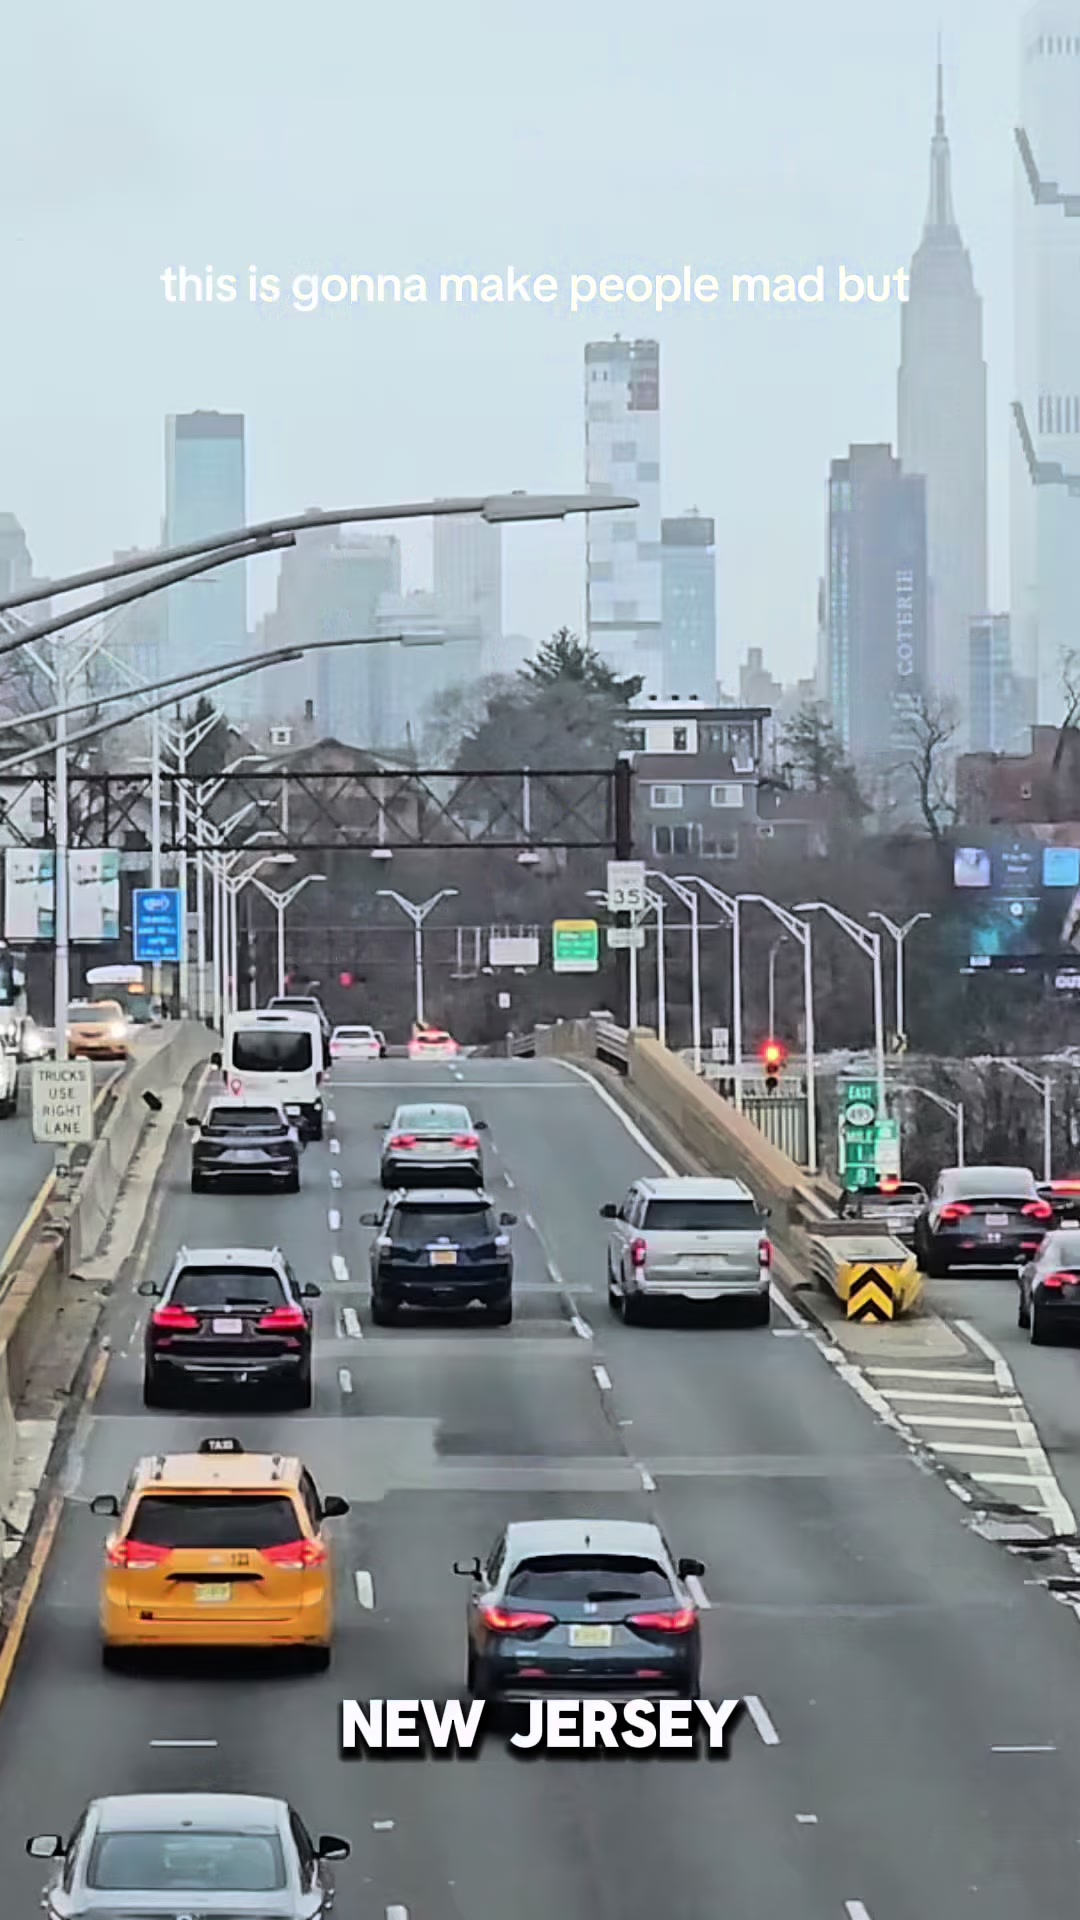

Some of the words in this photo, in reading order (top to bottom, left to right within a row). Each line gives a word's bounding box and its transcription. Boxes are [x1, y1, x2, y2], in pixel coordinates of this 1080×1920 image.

[895, 569, 914, 676] COTERIE
[613, 888, 641, 905] 35
[39, 1070, 87, 1082] TRUCKS
[48, 1086, 77, 1100] USE
[848, 1085, 873, 1100] EAST
[42, 1104, 82, 1117] RIGHT
[851, 1106, 872, 1119] 495
[44, 1121, 82, 1136] LANE
[208, 1439, 234, 1450] TAXI
